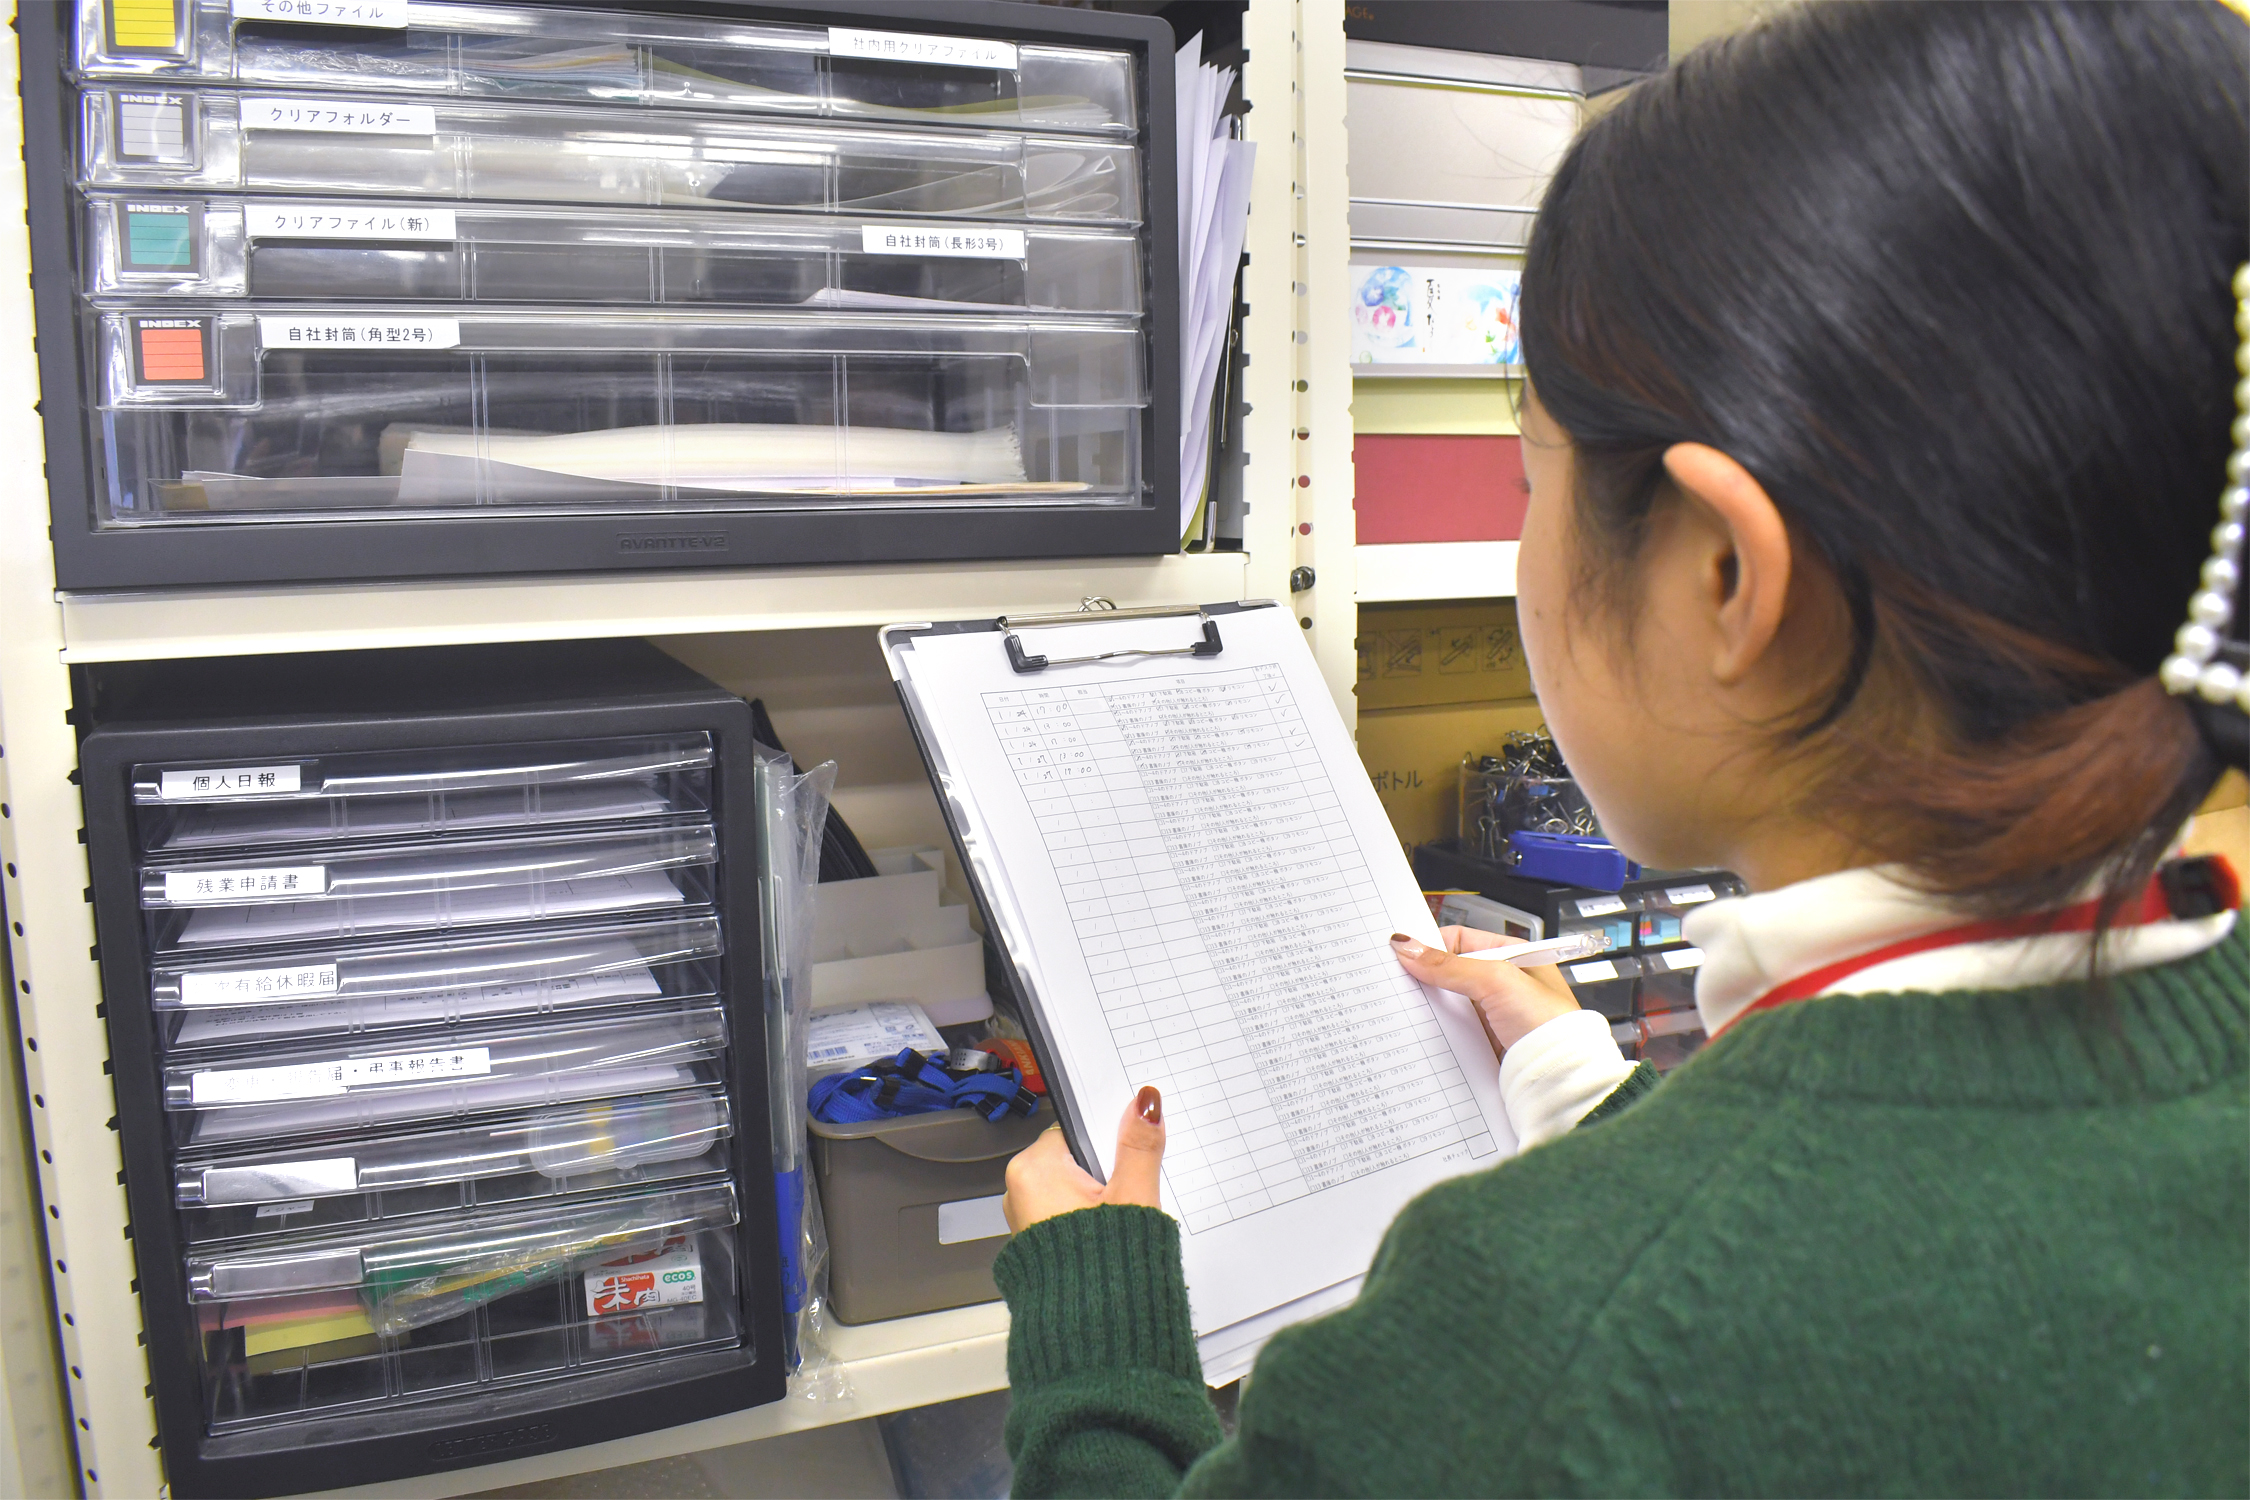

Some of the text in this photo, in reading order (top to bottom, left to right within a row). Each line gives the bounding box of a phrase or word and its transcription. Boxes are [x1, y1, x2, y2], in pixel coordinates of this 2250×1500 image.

[261, 0, 384, 19] その他ファイル
[853, 36, 998, 60] 社内用クリアファイル
[120, 94, 184, 105] INDEX
[270, 107, 411, 126] クリアフォルダー
[127, 204, 190, 214] INDEX
[274, 215, 431, 232] クリアファイル(新)
[886, 234, 1004, 251] 自社封筒(長形3号)
[139, 319, 202, 328] INDEX
[289, 326, 434, 343] 自社封筒(角型2号)
[192, 772, 276, 791] 個人日報
[1371, 770, 1423, 792] ボトル
[196, 874, 300, 894] 残業申請書
[620, 1274, 650, 1283] Shachihata
[663, 1270, 695, 1283] ecos
[590, 1276, 660, 1311] 朱肉
